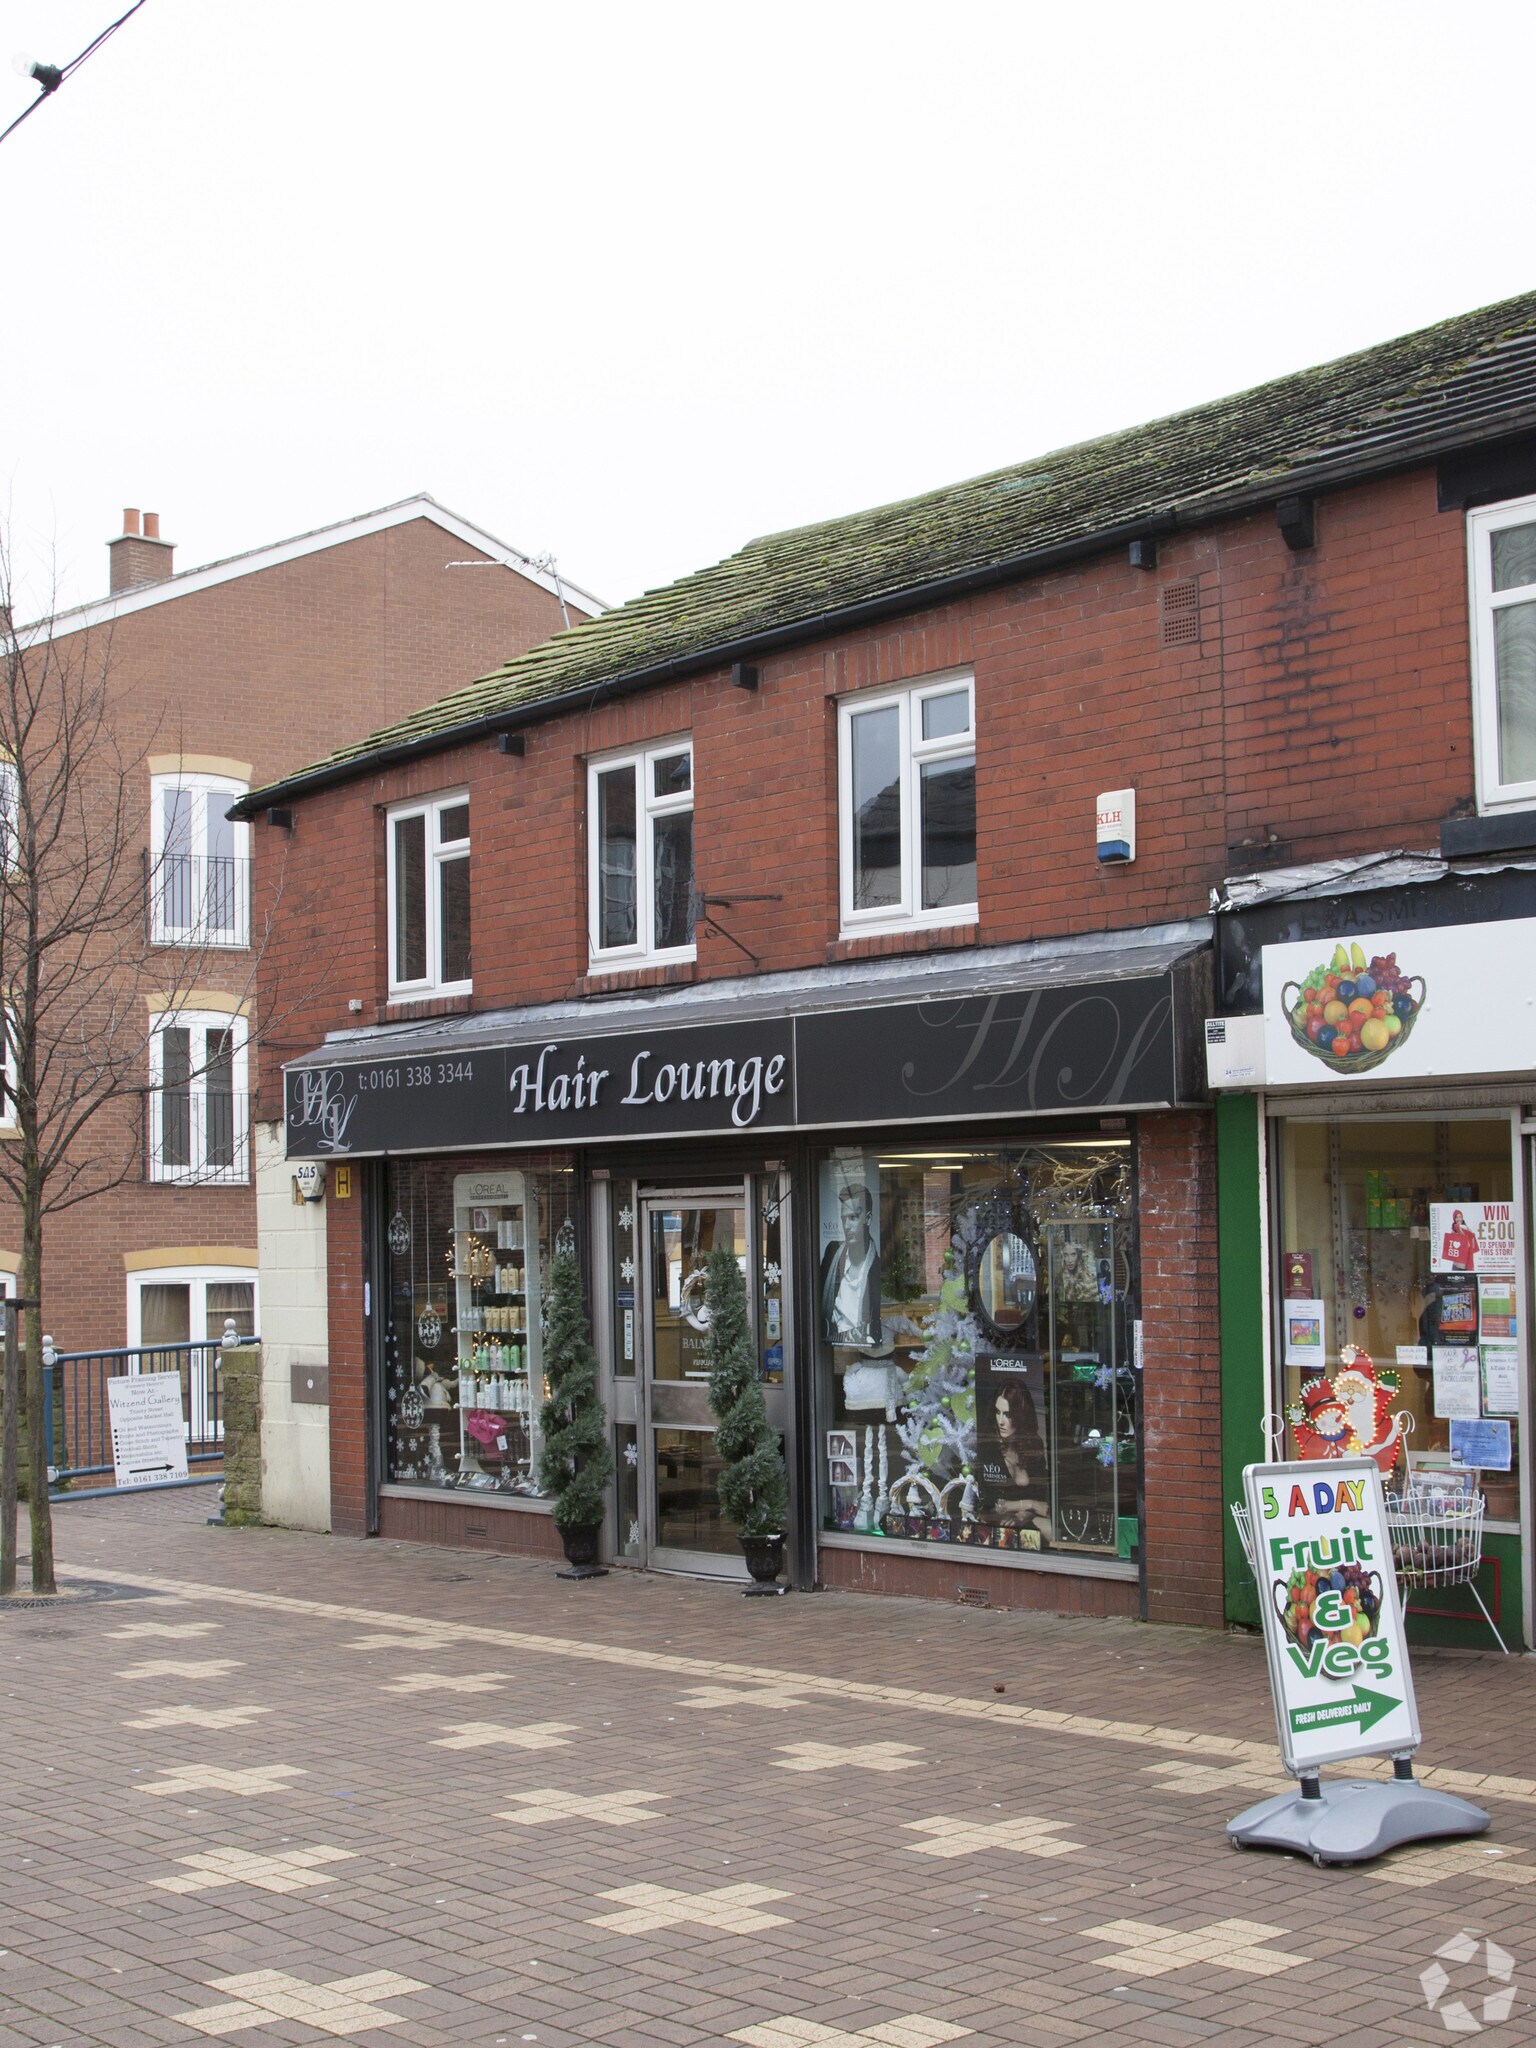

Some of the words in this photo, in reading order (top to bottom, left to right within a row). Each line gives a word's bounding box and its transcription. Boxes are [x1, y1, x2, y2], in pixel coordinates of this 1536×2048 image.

[1096, 811, 1122, 825] KLH
[370, 1068, 400, 1090] 0161
[406, 1065, 432, 1087] 338
[437, 1061, 473, 1085] 3344
[510, 1044, 609, 1114] Hair
[620, 1050, 785, 1127] Lounge
[297, 1166, 316, 1179] SAS
[337, 1170, 349, 1194] H
[1483, 1205, 1509, 1220] WIN
[110, 1398, 146, 1408] Witzend
[148, 1395, 180, 1405] Gallery
[134, 1475, 152, 1483] 0161
[170, 1471, 188, 1479] 7109
[984, 1462, 1000, 1473] NÉO
[1262, 1487, 1279, 1520] 5
[1288, 1484, 1310, 1517] A
[1313, 1479, 1366, 1514] DAY
[1269, 1526, 1374, 1571] Fruit
[1315, 1593, 1352, 1628] &
[1285, 1637, 1393, 1680] Veg
[1295, 1712, 1316, 1724] FRESH
[1316, 1705, 1352, 1720] DELIVERIES
[1352, 1701, 1372, 1714] DAILY
